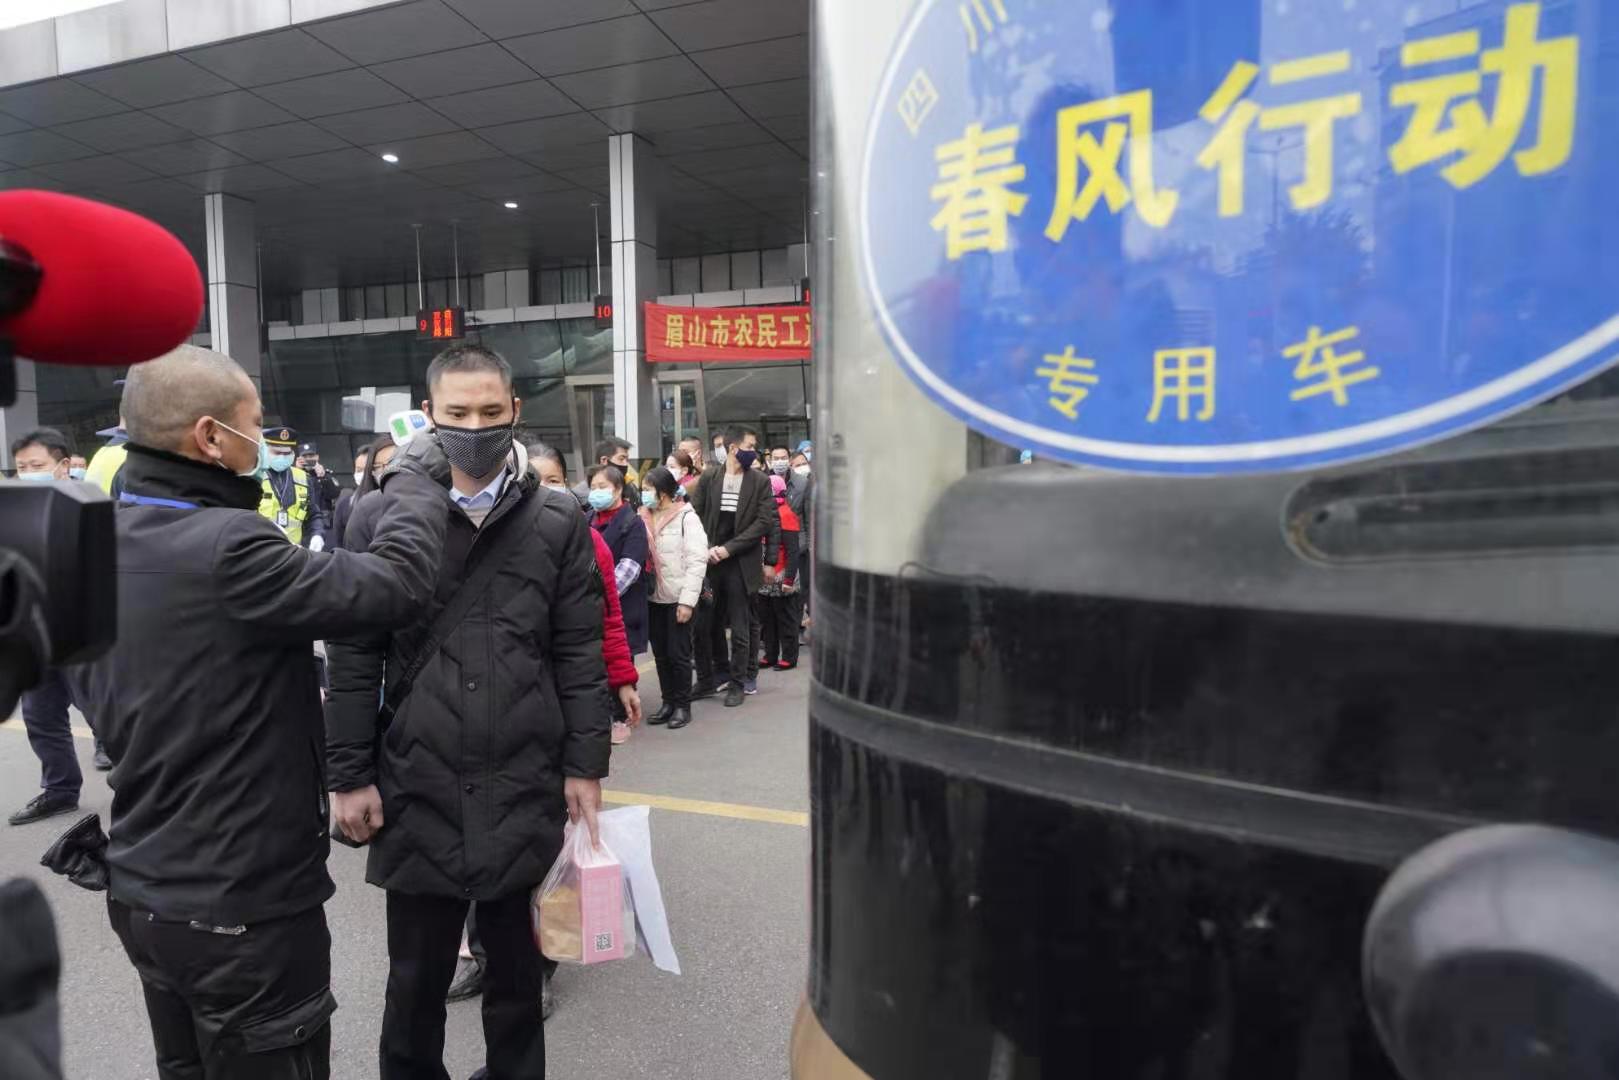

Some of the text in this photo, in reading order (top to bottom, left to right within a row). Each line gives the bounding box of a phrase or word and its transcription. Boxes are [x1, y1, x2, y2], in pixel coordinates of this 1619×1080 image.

[930, 2, 1579, 259] 春风行动
[419, 319, 428, 332] 9
[597, 304, 612, 319] 10
[1035, 326, 1379, 423] 专用车
